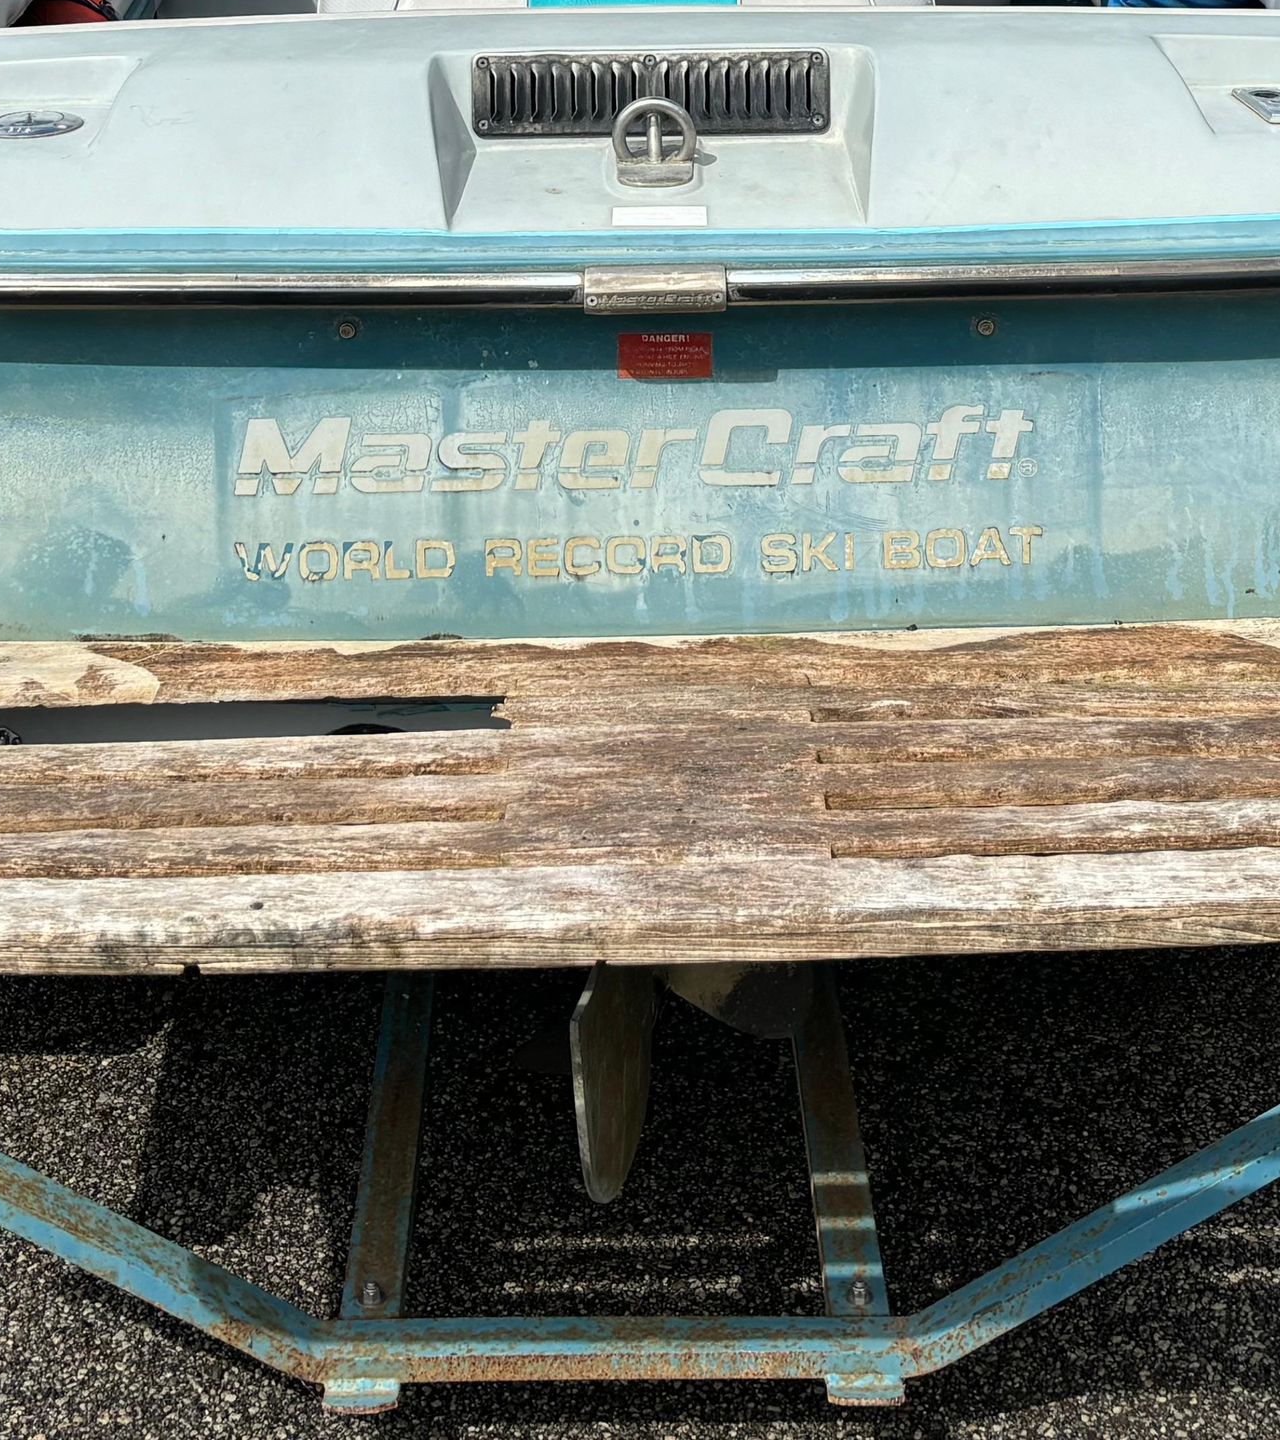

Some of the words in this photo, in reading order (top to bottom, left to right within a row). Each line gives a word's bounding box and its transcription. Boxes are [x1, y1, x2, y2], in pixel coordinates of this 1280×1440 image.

[641, 334, 691, 343] DANGER!
[234, 539, 456, 582] WORLD
[484, 532, 733, 579] RECORD
[760, 532, 855, 574] SKI
[882, 526, 1043, 571] BOAT
